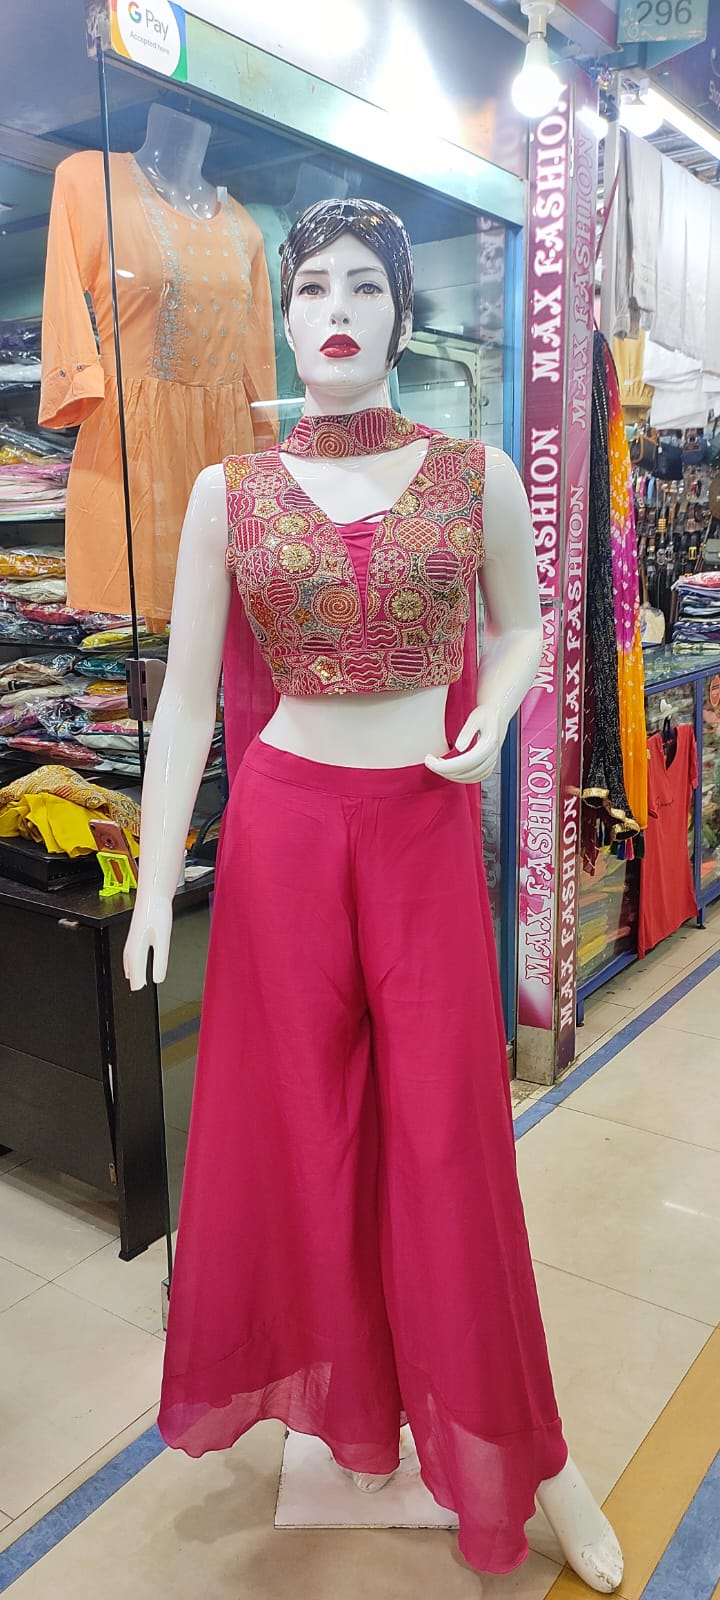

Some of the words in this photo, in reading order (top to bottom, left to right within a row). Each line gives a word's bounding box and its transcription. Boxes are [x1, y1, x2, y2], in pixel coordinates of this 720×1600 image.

[130, 31, 157, 49] Accepted
[157, 43, 170, 55] here
[145, 9, 169, 41] Pay
[636, 0, 692, 26] 296
[573, 136, 593, 323] FASHION
[531, 284, 562, 384] MAX
[572, 333, 588, 429] MAX
[567, 485, 584, 652] FASHION
[565, 659, 580, 743] MAX
[527, 745, 553, 899] FASHION
[561, 795, 577, 945] FASHION
[525, 903, 553, 985] MAX
[560, 949, 575, 1033] MAX
